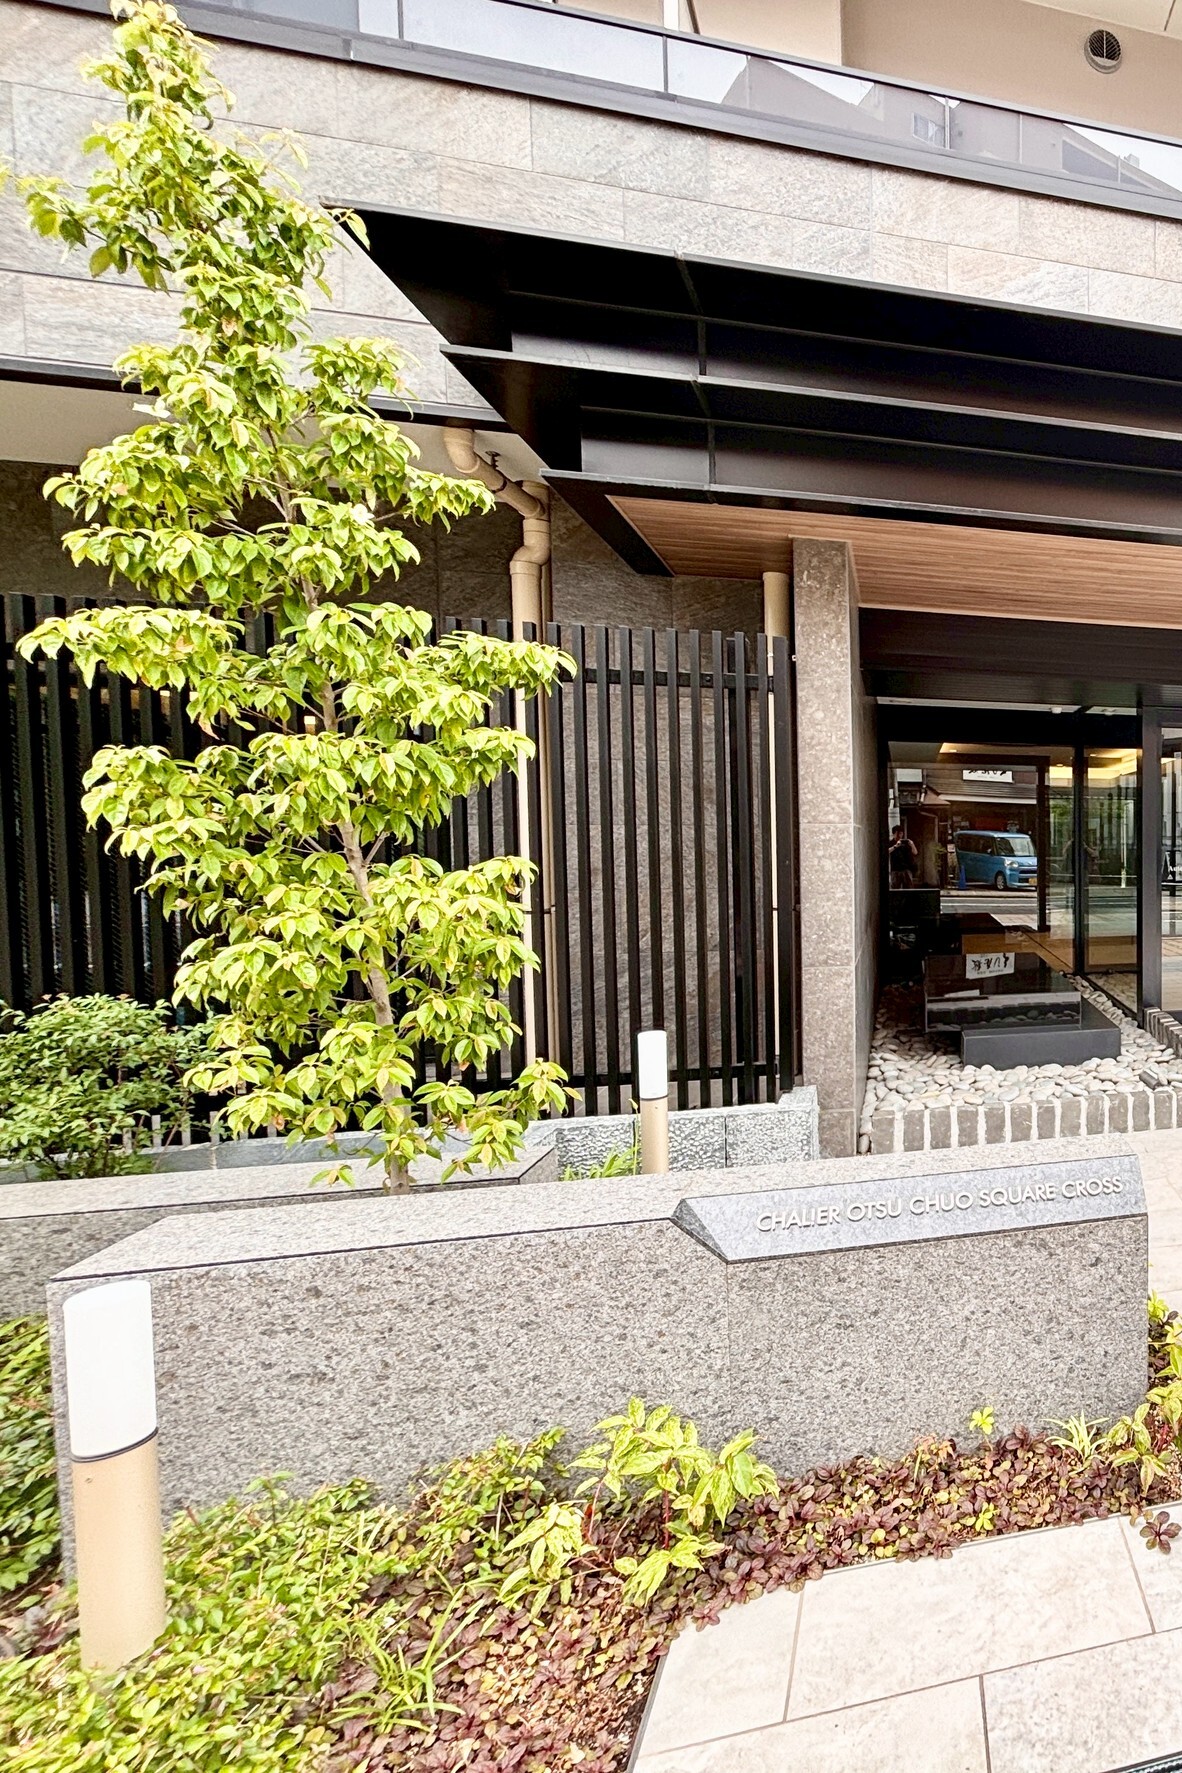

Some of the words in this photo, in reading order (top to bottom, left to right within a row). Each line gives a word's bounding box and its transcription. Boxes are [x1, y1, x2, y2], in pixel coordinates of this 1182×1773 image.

[756, 1205, 841, 1232] CHALIER
[847, 1200, 902, 1222] OTSU
[909, 1191, 974, 1215] CHUO
[979, 1182, 1056, 1208] SQUARE
[1061, 1175, 1124, 1199] CROSS
